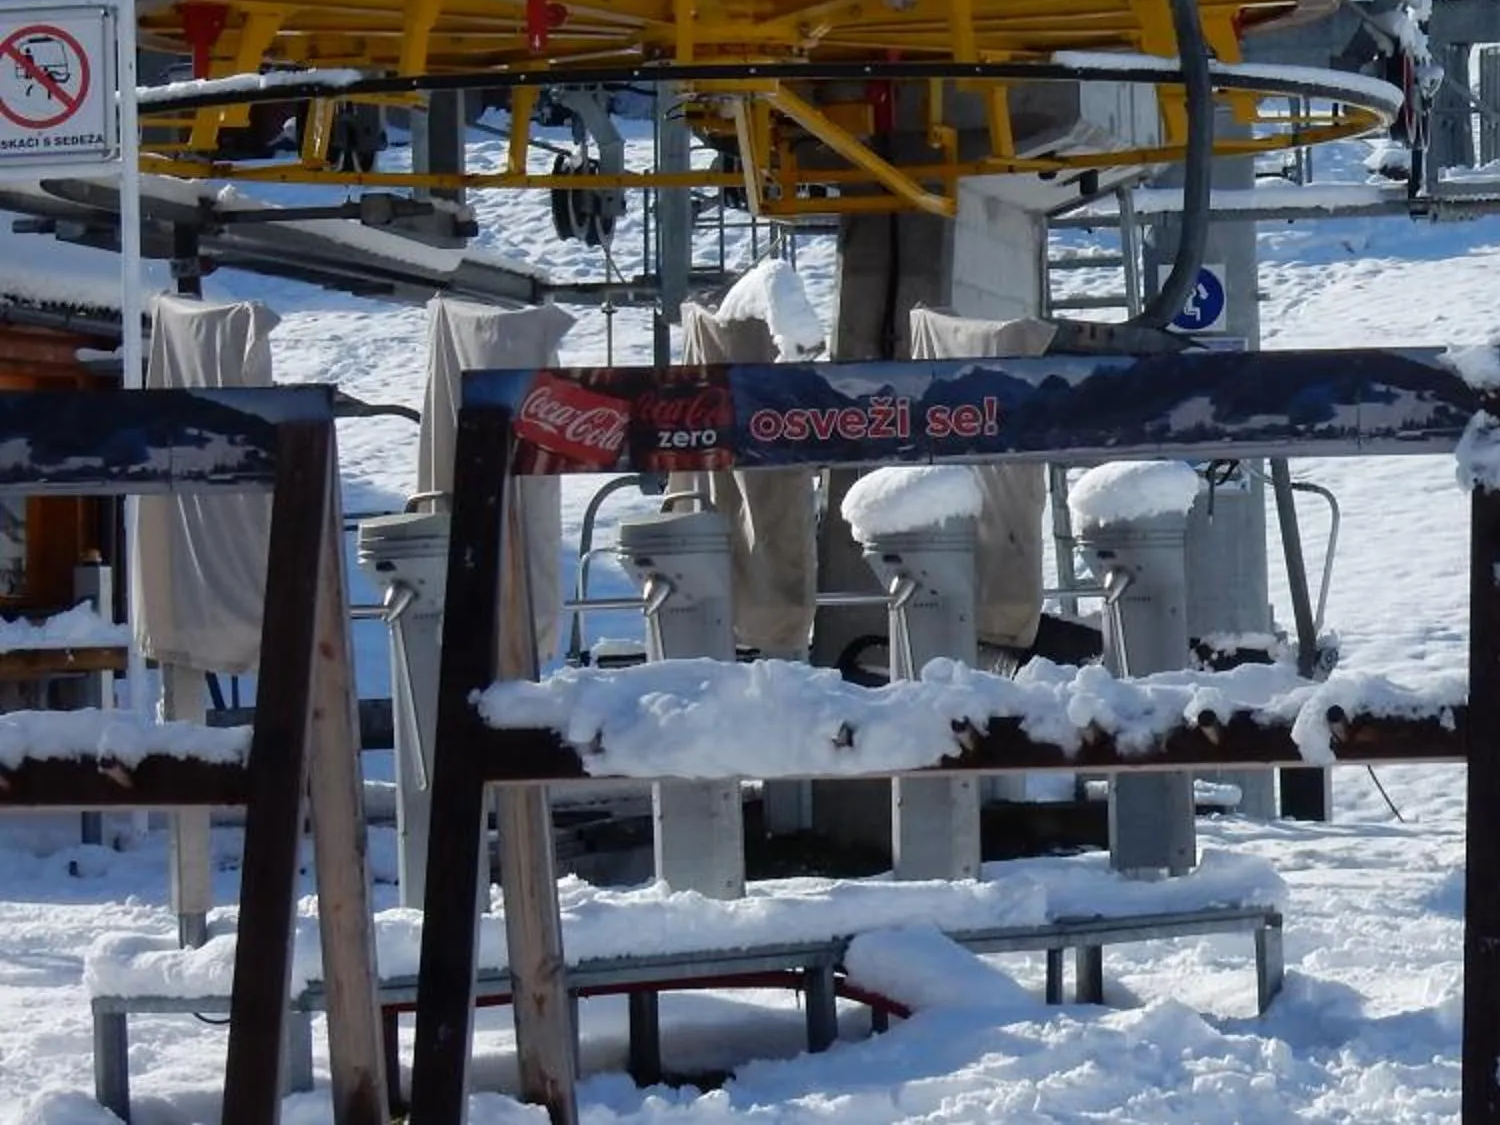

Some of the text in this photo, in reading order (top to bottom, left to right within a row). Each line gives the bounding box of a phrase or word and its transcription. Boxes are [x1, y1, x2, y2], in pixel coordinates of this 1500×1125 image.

[520, 386, 630, 452] Coca-Cola
[657, 428, 718, 449] zero
[749, 395, 999, 442] osveži se!
